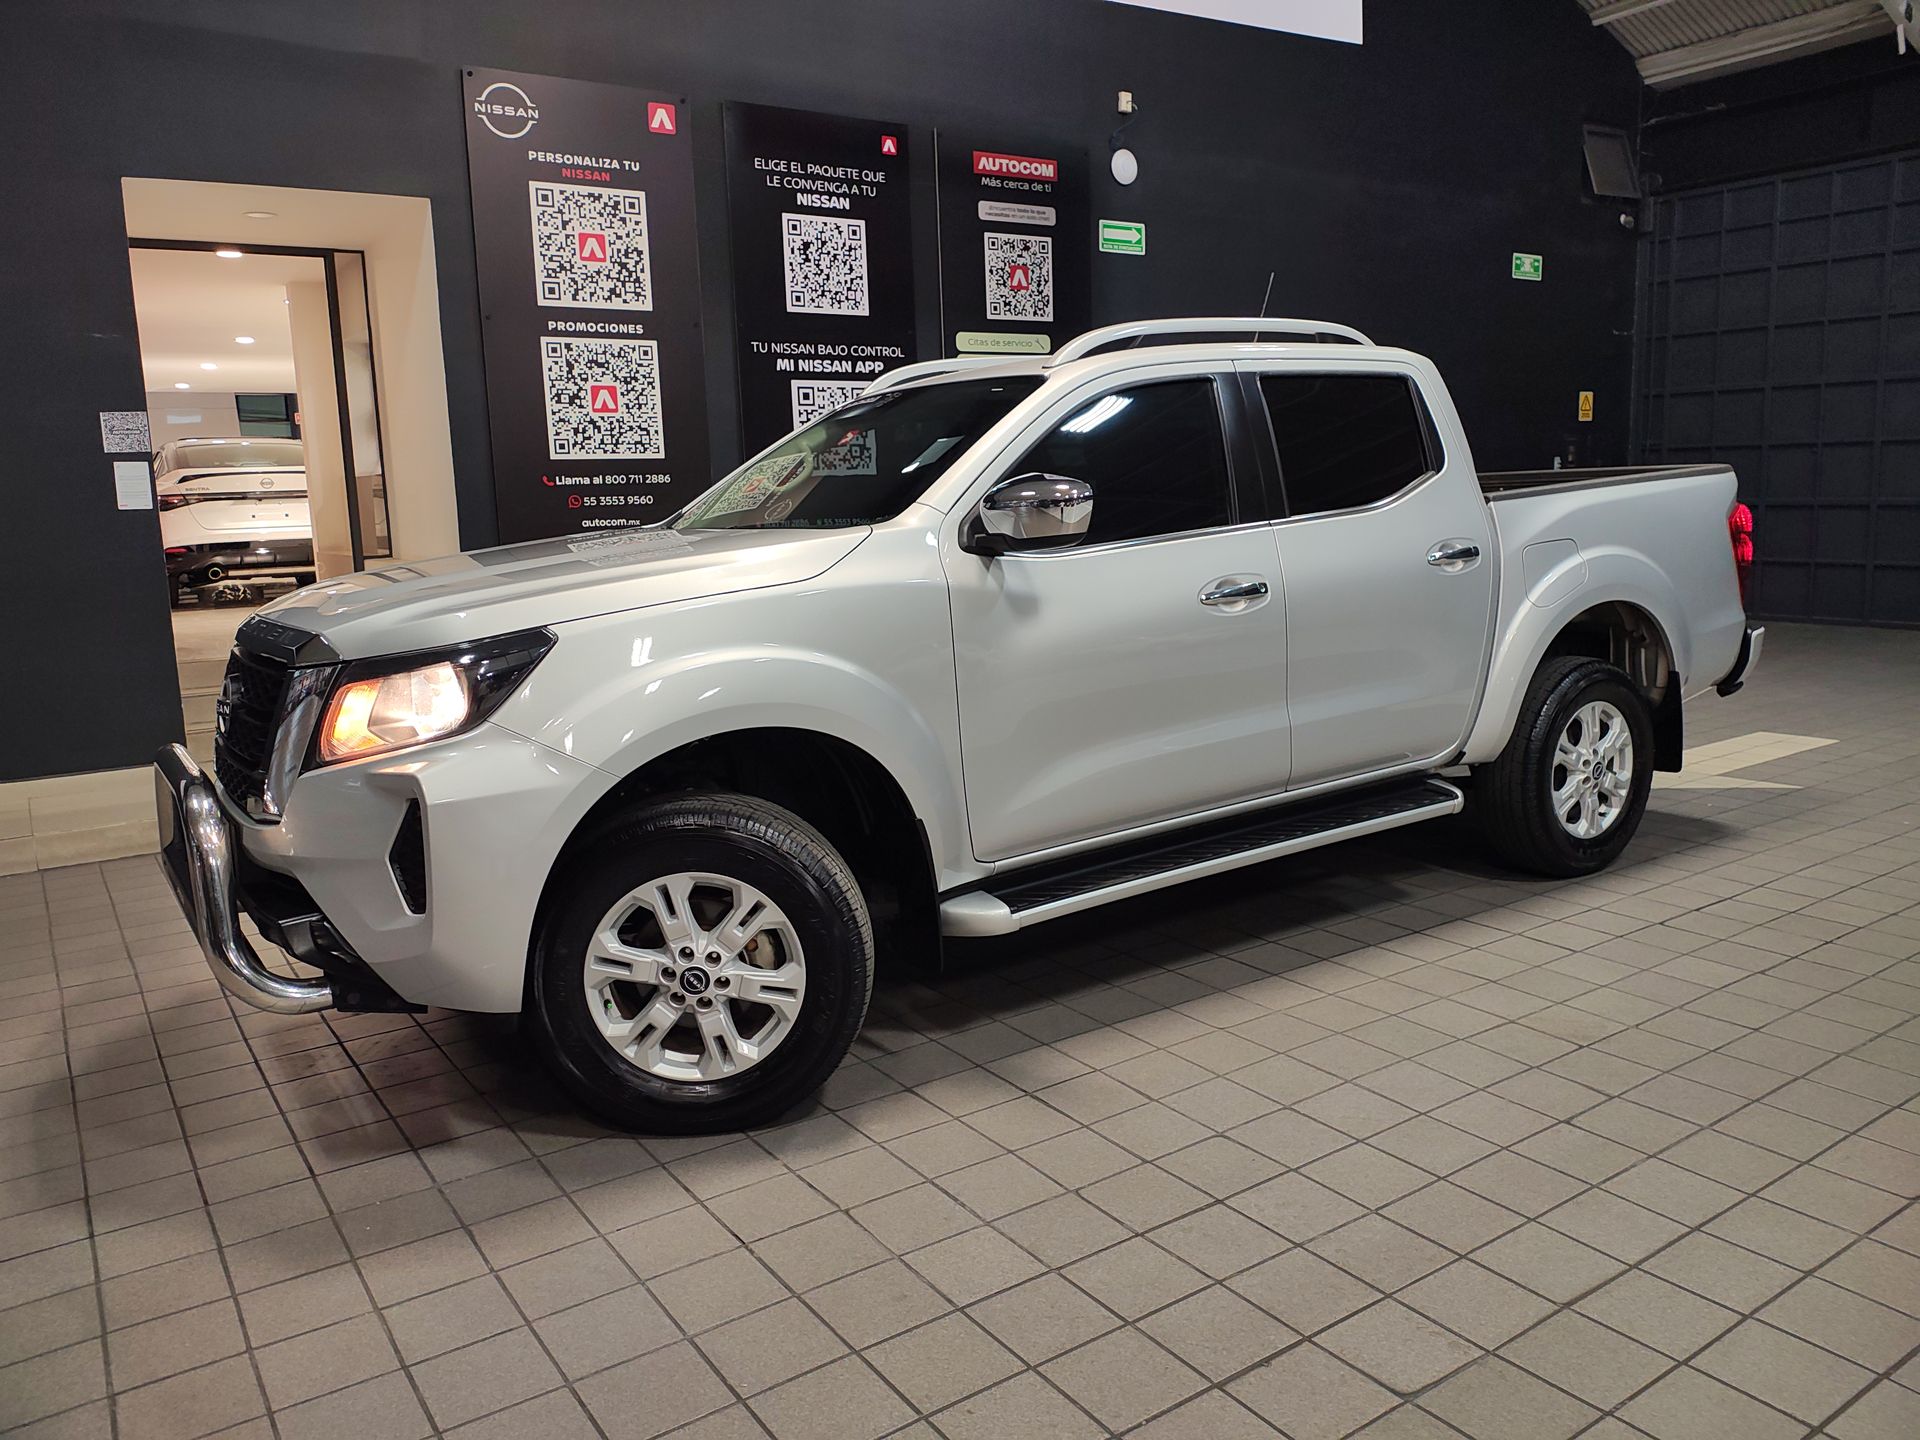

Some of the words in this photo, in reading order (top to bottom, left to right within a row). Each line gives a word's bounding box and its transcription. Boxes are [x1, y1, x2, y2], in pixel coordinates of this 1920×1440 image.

[474, 102, 539, 119] NISSAN
[528, 150, 620, 170] PERSONALIZA
[622, 160, 640, 171] TU
[978, 156, 1054, 177] AUTOCOM
[561, 168, 611, 181] NISSAN
[754, 157, 788, 172] ELIGE
[790, 161, 805, 174] EL
[807, 163, 860, 180] PAQUETE
[862, 170, 886, 183] QUE
[766, 175, 781, 187] LE
[783, 177, 849, 194] CONVENGA
[851, 184, 859, 195] A
[861, 185, 876, 196] TU
[981, 175, 1002, 188] Más
[1003, 180, 1029, 190] cerca
[1031, 181, 1043, 192] de
[1044, 183, 1052, 192] ti
[796, 192, 850, 210] NISSAN
[548, 320, 644, 335] PROMOCIONES
[751, 341, 768, 353] TU
[771, 342, 815, 355] NISSAN
[818, 344, 848, 356] BAJO
[850, 345, 905, 358] CONTROL
[968, 338, 989, 347] Citas
[990, 338, 1001, 347] de
[1002, 338, 1033, 348] servicio
[776, 358, 794, 372] MI
[798, 359, 853, 373] NISSAN
[855, 361, 884, 373] APP
[555, 475, 590, 485] Llama
[592, 474, 603, 485] al
[605, 475, 627, 484] 800
[629, 475, 643, 484] 711
[645, 474, 671, 484] 2886
[583, 496, 597, 506] 55
[599, 495, 626, 505] 3553
[628, 495, 653, 505] 9560
[581, 517, 640, 528] autocom.mx
